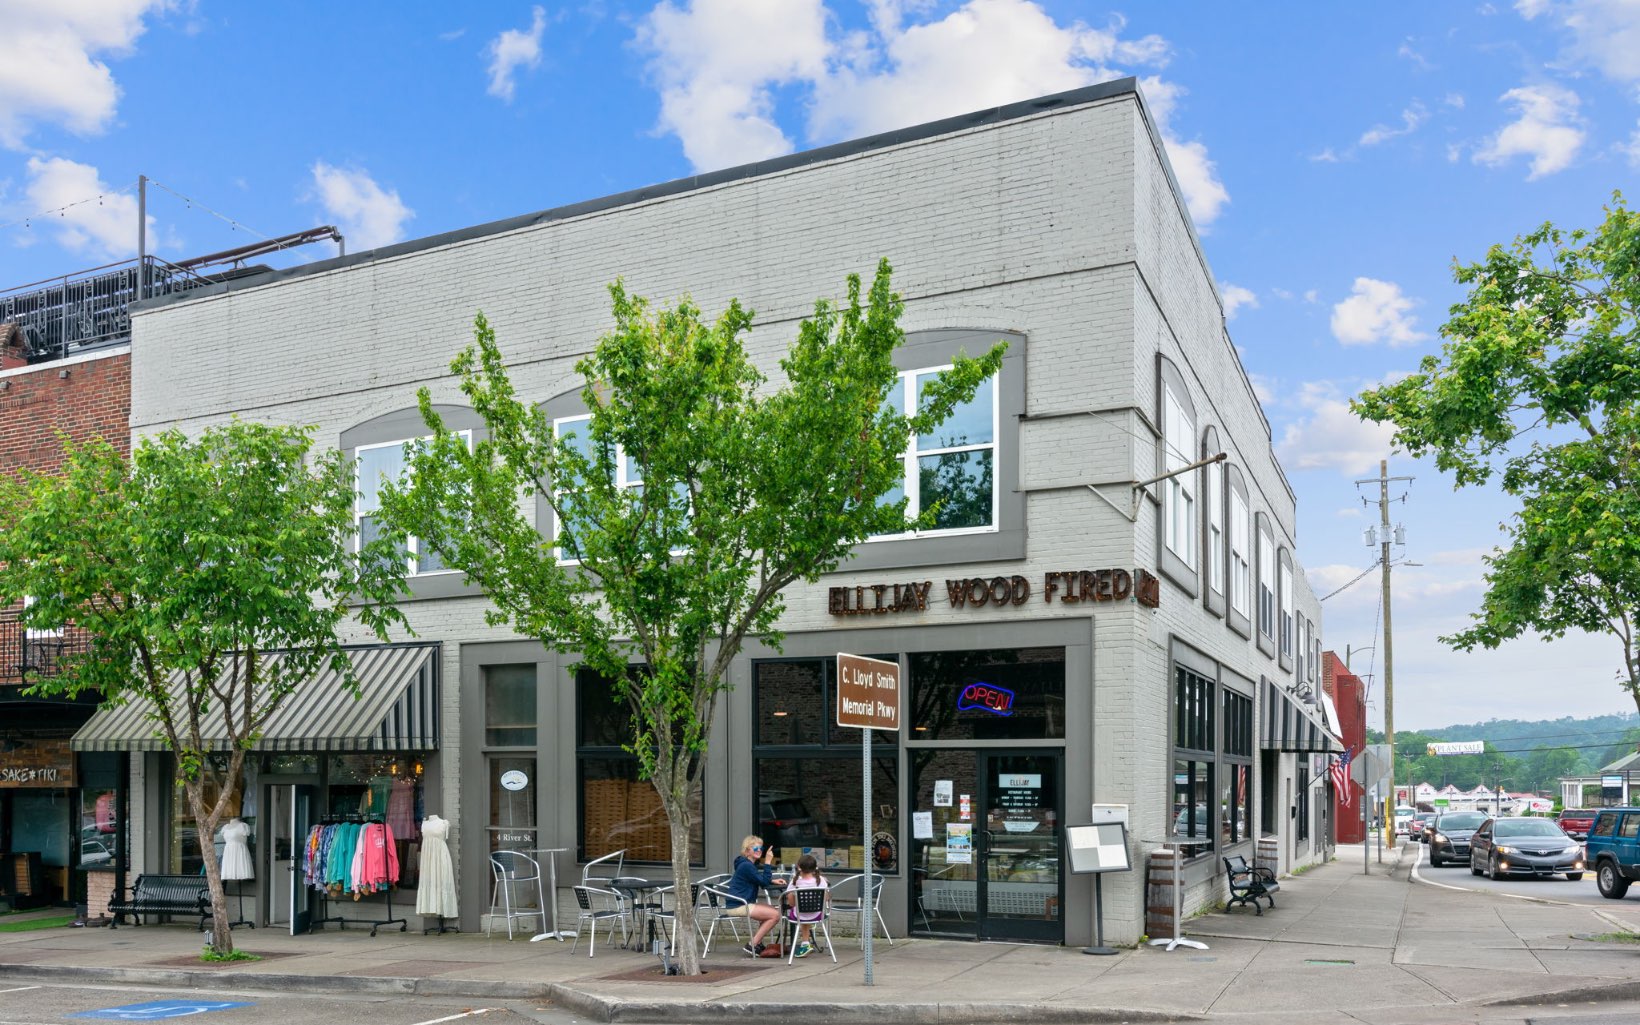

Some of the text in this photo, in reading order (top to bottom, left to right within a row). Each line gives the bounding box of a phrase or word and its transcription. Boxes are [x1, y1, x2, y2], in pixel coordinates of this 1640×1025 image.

[828, 568, 1132, 616] ELLIJAY WOOD FIRED
[842, 665, 896, 690] C. Lloyd Smith
[842, 696, 896, 722] Memorial Pkwy
[965, 685, 1010, 710] OPEN
[1, 767, 29, 782] SAKE
[503, 833, 521, 842] River
[523, 833, 533, 842] St.
